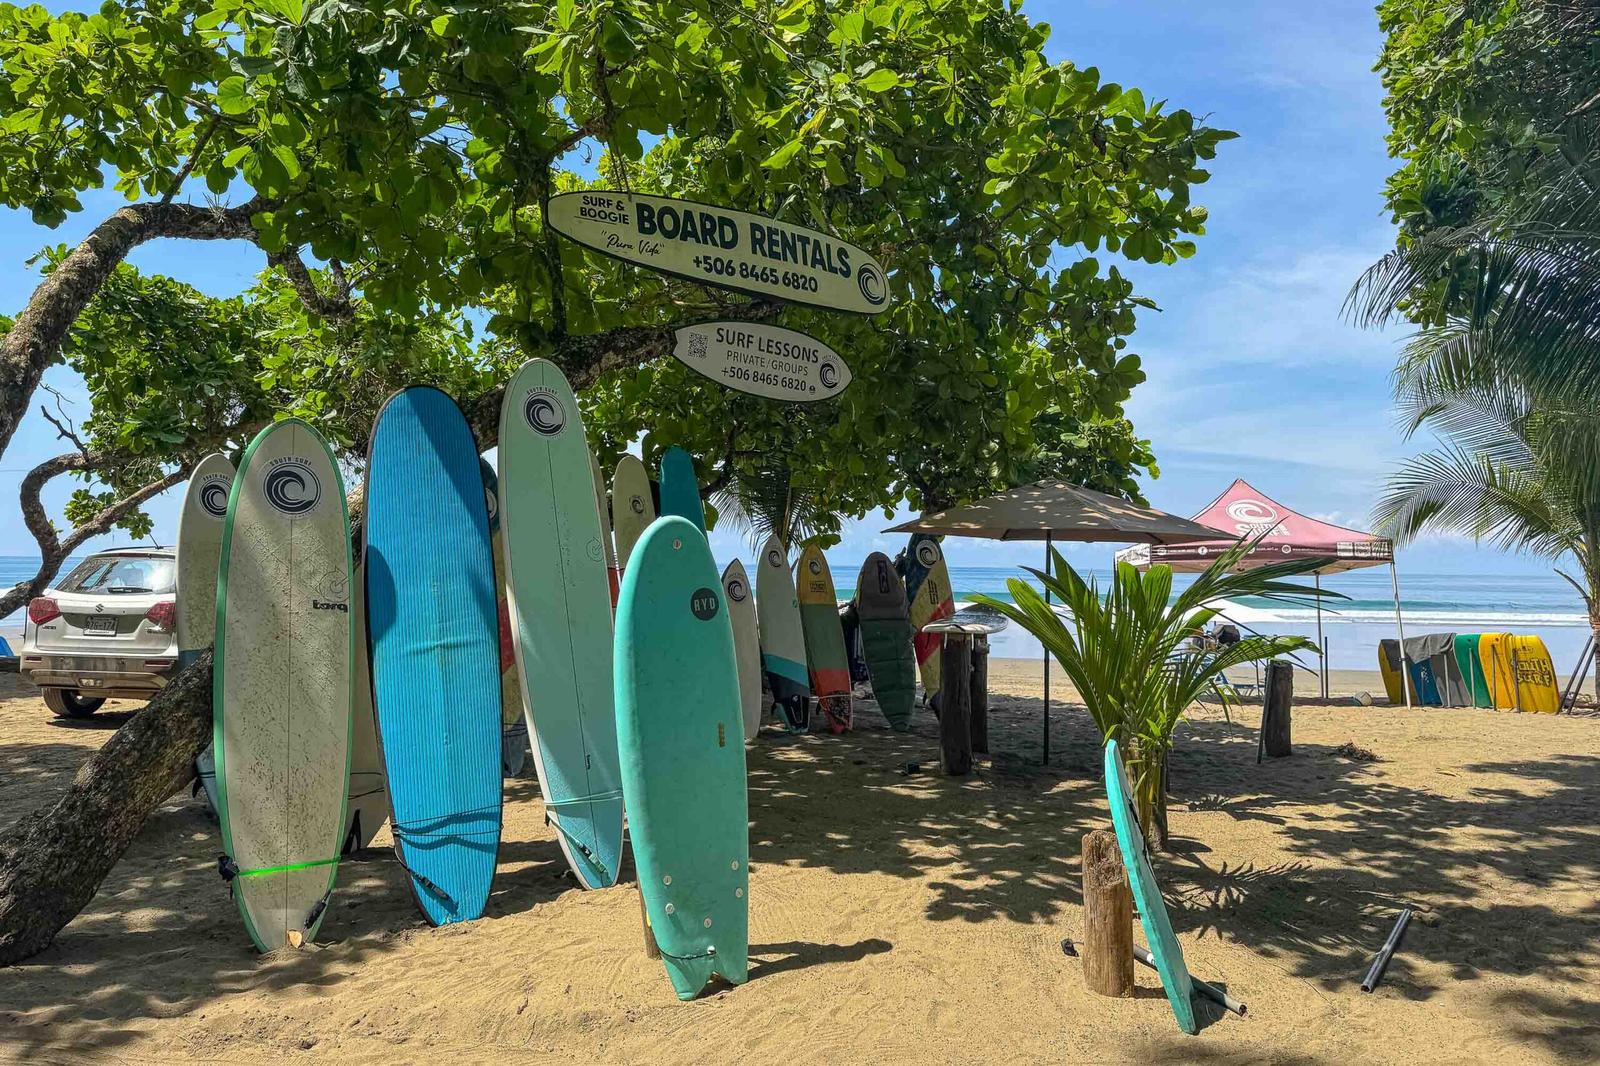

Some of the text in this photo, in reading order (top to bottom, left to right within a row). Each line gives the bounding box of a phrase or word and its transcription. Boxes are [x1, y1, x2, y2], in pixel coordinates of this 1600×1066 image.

[582, 195, 625, 211] SURF &
[579, 206, 630, 225] BOOGIE
[635, 202, 851, 279] BOARD RENTALS
[692, 255, 819, 293] +506 8465 6820
[715, 327, 819, 364] SURF LESSONS
[721, 366, 807, 392] +506 8465 6820
[312, 599, 348, 613] torq
[693, 597, 716, 612] RYD
